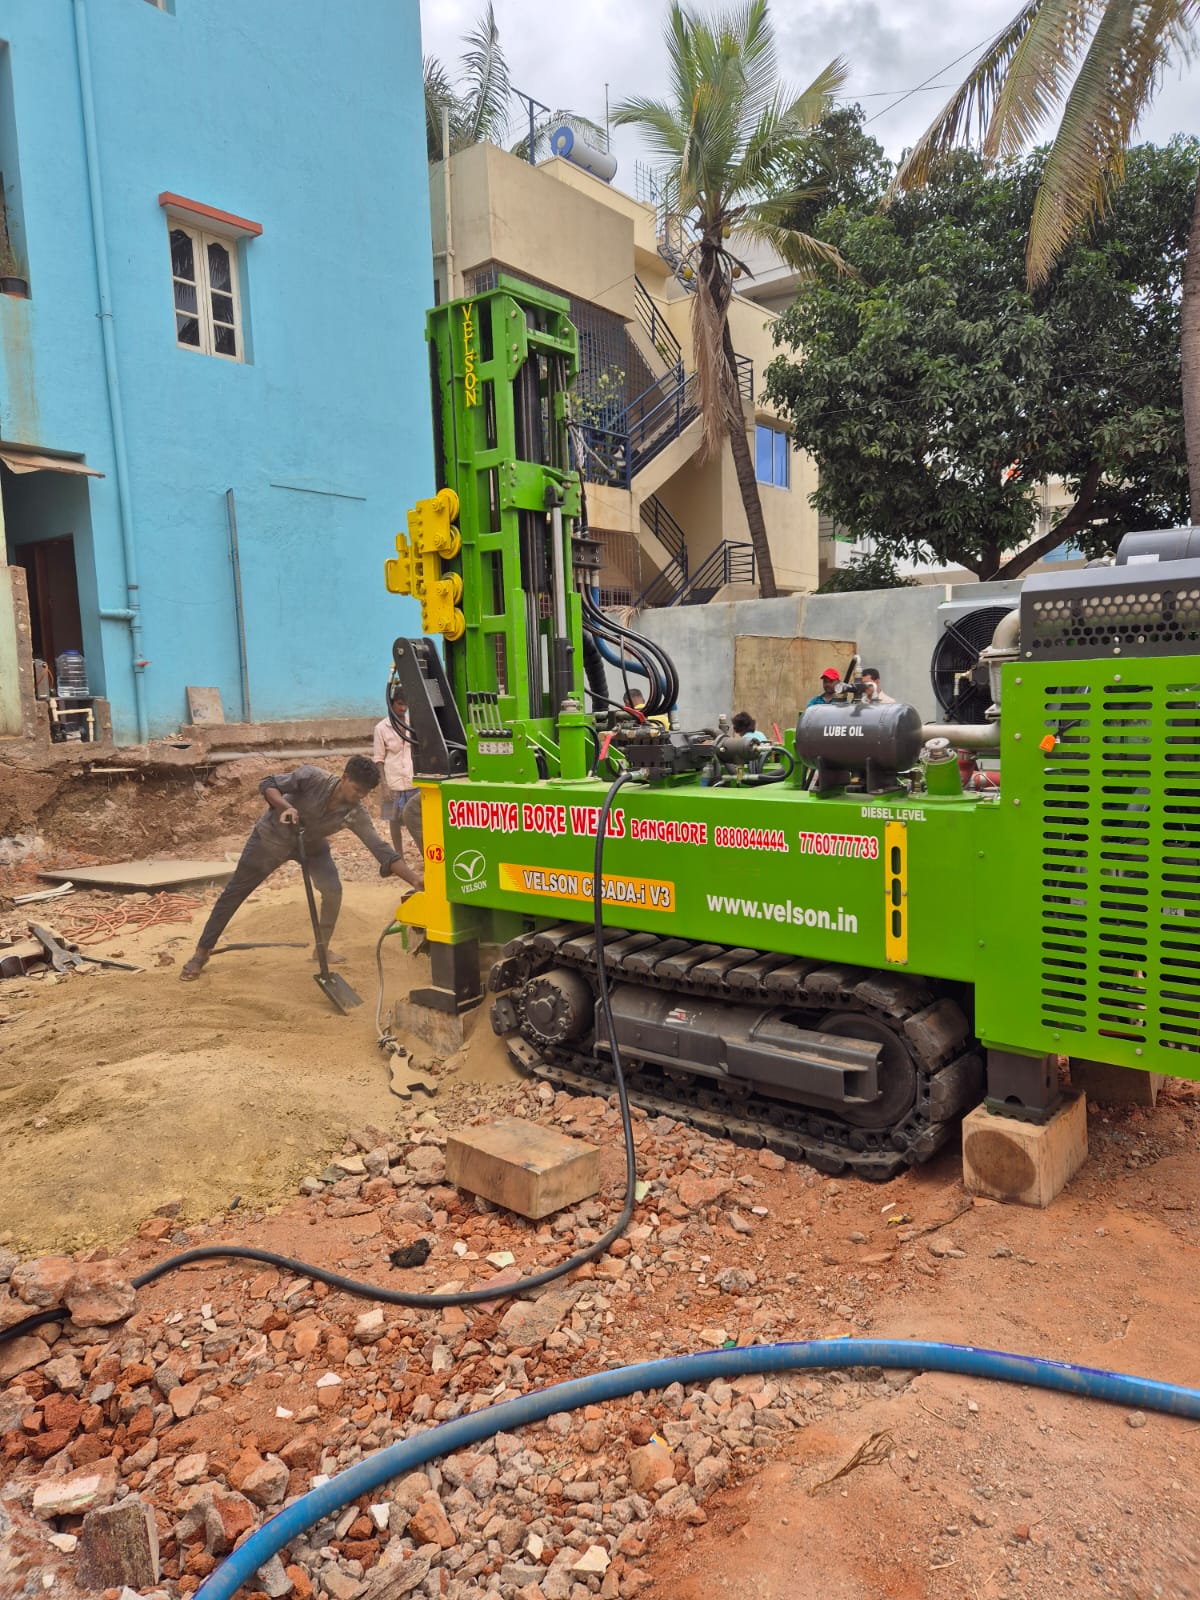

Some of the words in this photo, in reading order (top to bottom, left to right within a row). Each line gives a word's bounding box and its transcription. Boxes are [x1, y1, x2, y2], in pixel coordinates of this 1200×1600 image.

[462, 303, 477, 408] VELSON
[823, 725, 846, 737] LUBE
[849, 725, 864, 737] OIL
[448, 799, 518, 833] SANIDHYA
[522, 804, 566, 837] BORE
[631, 819, 707, 846] BANGALORE
[714, 826, 789, 852] 8880844444.
[799, 831, 879, 859] 7760777733
[861, 806, 894, 820] DIESEL
[896, 808, 927, 822] LEVEL
[461, 880, 487, 894] VELSON
[523, 870, 578, 895] VELSON
[649, 885, 671, 907] V3
[706, 893, 858, 934] www.velson.in
